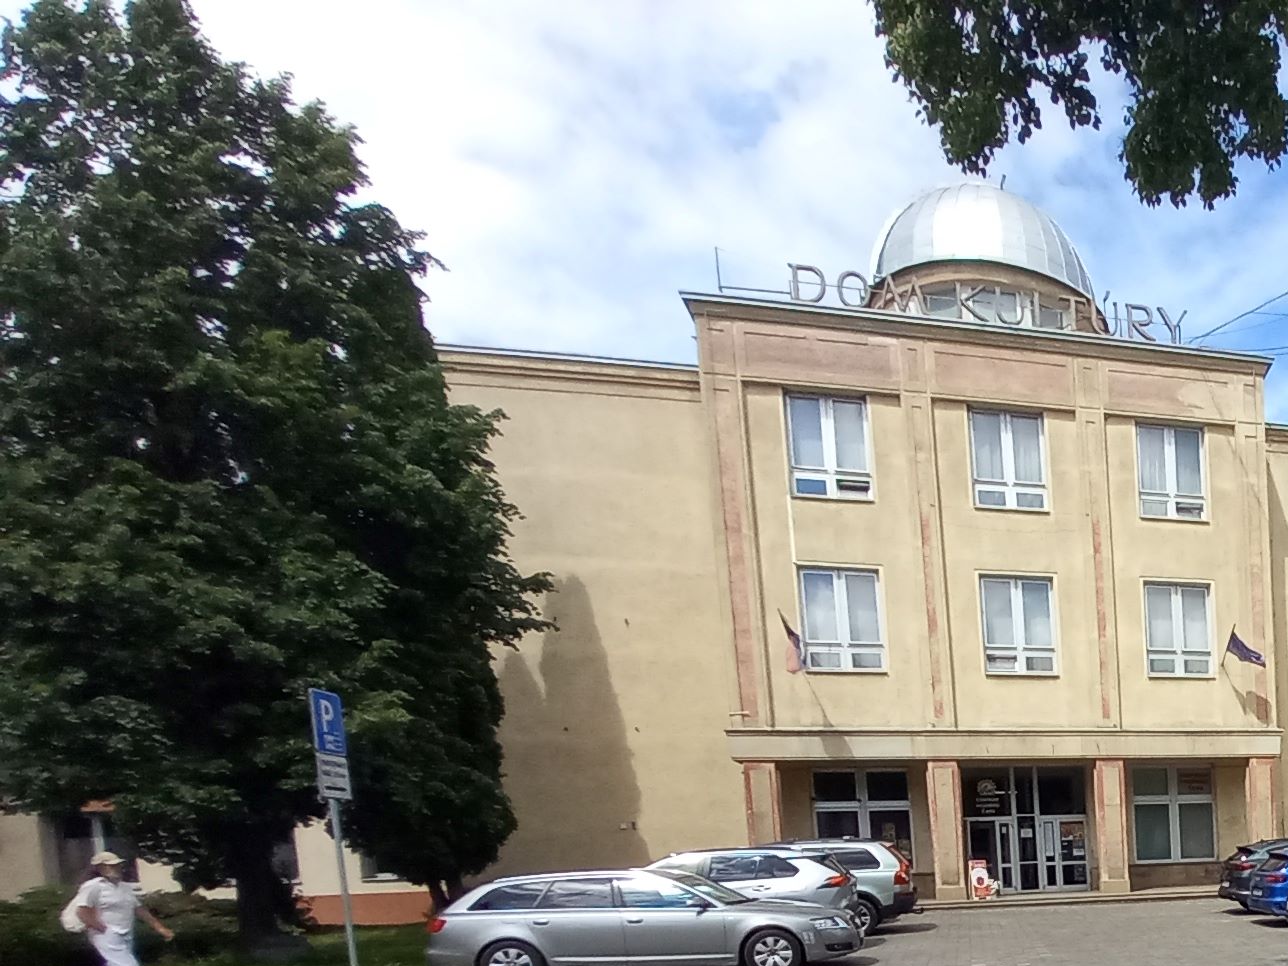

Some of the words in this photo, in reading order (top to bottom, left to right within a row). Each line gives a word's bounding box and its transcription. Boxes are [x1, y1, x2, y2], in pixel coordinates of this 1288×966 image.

[787, 262, 930, 315] DOM
[953, 280, 1188, 345] KULTÚRY
[319, 699, 334, 732] P
